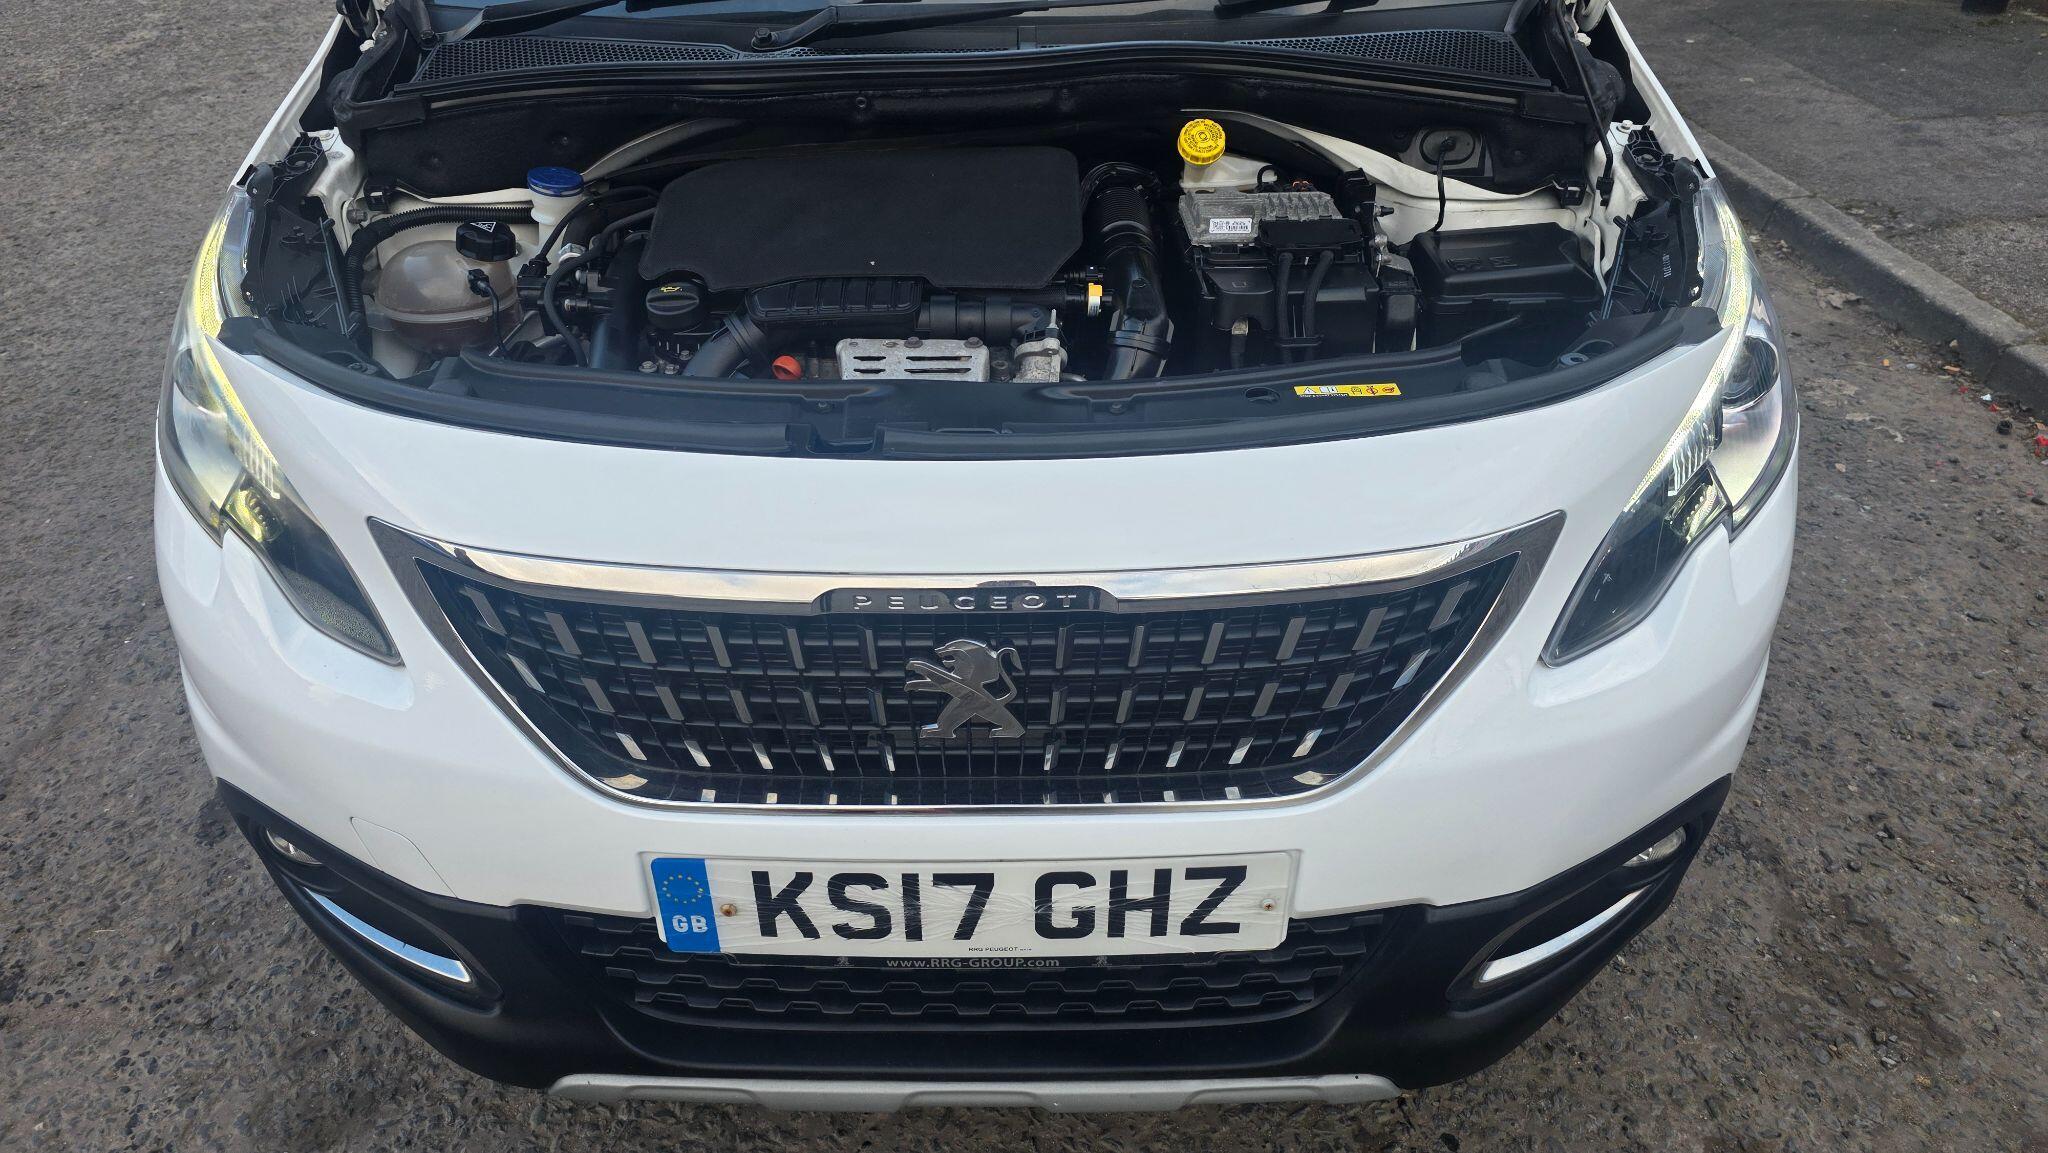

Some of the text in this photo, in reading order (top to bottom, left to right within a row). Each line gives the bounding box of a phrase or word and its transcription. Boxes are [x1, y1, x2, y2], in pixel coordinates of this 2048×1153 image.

[854, 594, 1077, 611] PEUGEOT
[751, 865, 1248, 942] KS17 GHZ
[672, 914, 709, 933] GB
[886, 957, 1060, 968] www.RRG-GROUP.com
